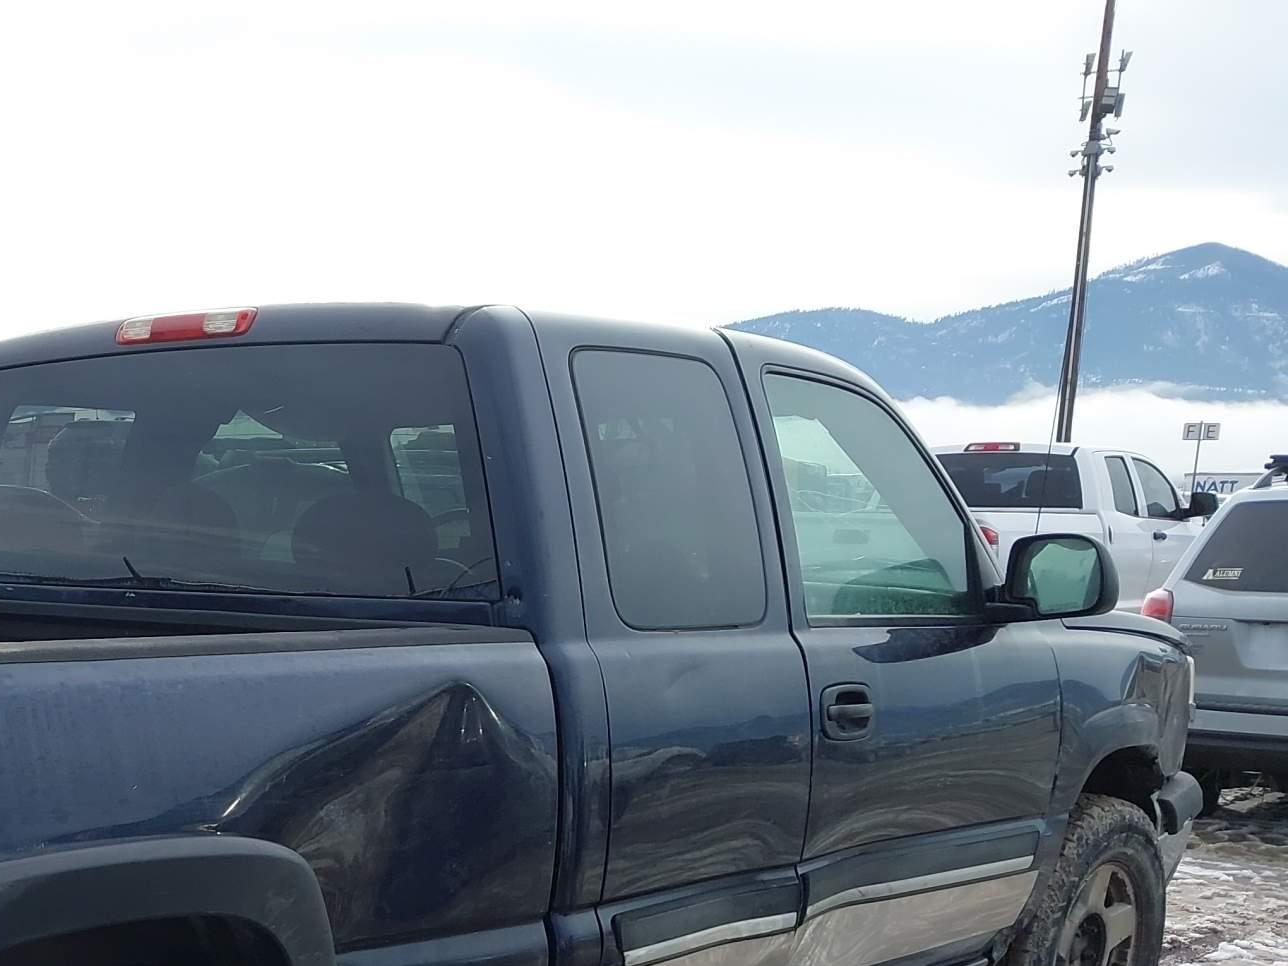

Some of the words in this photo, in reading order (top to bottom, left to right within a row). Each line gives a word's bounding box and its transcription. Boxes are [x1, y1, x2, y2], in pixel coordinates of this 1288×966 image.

[1186, 424, 1196, 438] F
[1205, 424, 1216, 438] E
[1194, 480, 1239, 493] NATT
